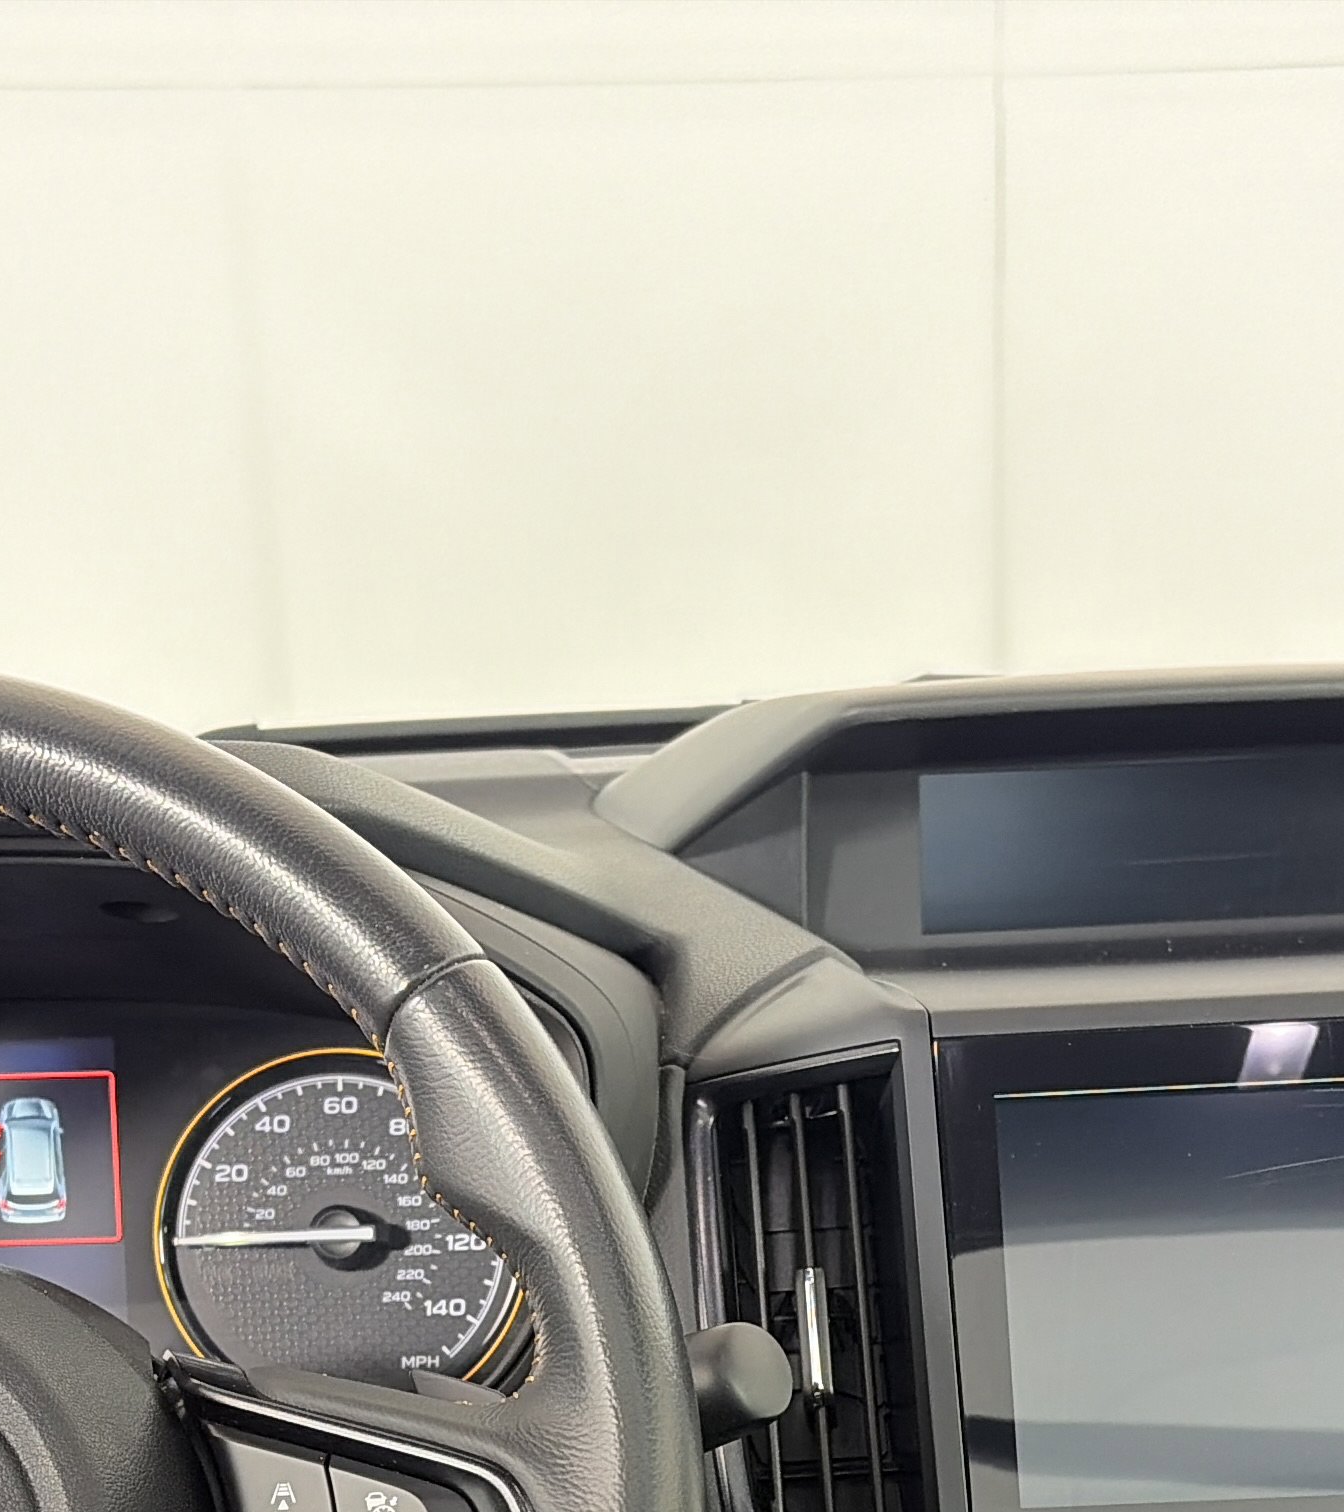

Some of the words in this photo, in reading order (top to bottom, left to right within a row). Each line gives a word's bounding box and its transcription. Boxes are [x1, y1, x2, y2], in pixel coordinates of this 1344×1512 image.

[323, 1097, 358, 1114] 60
[254, 1116, 290, 1133] 40
[389, 1119, 410, 1135] 8
[310, 1154, 330, 1166] 80
[334, 1153, 359, 1164] 100
[327, 1165, 353, 1175] km/h
[362, 1159, 386, 1171] 120
[215, 1166, 248, 1183] 20
[285, 1166, 306, 1178] 60
[383, 1173, 408, 1184] 140
[266, 1185, 287, 1196] 40
[397, 1195, 422, 1207] 160
[255, 1208, 275, 1219] 20
[405, 1219, 430, 1230] 180
[445, 1233, 487, 1251] 120
[404, 1245, 432, 1256] 200
[396, 1269, 424, 1280] 220
[382, 1291, 411, 1303] 240
[425, 1299, 466, 1316] 140
[401, 1355, 440, 1369] MPH
